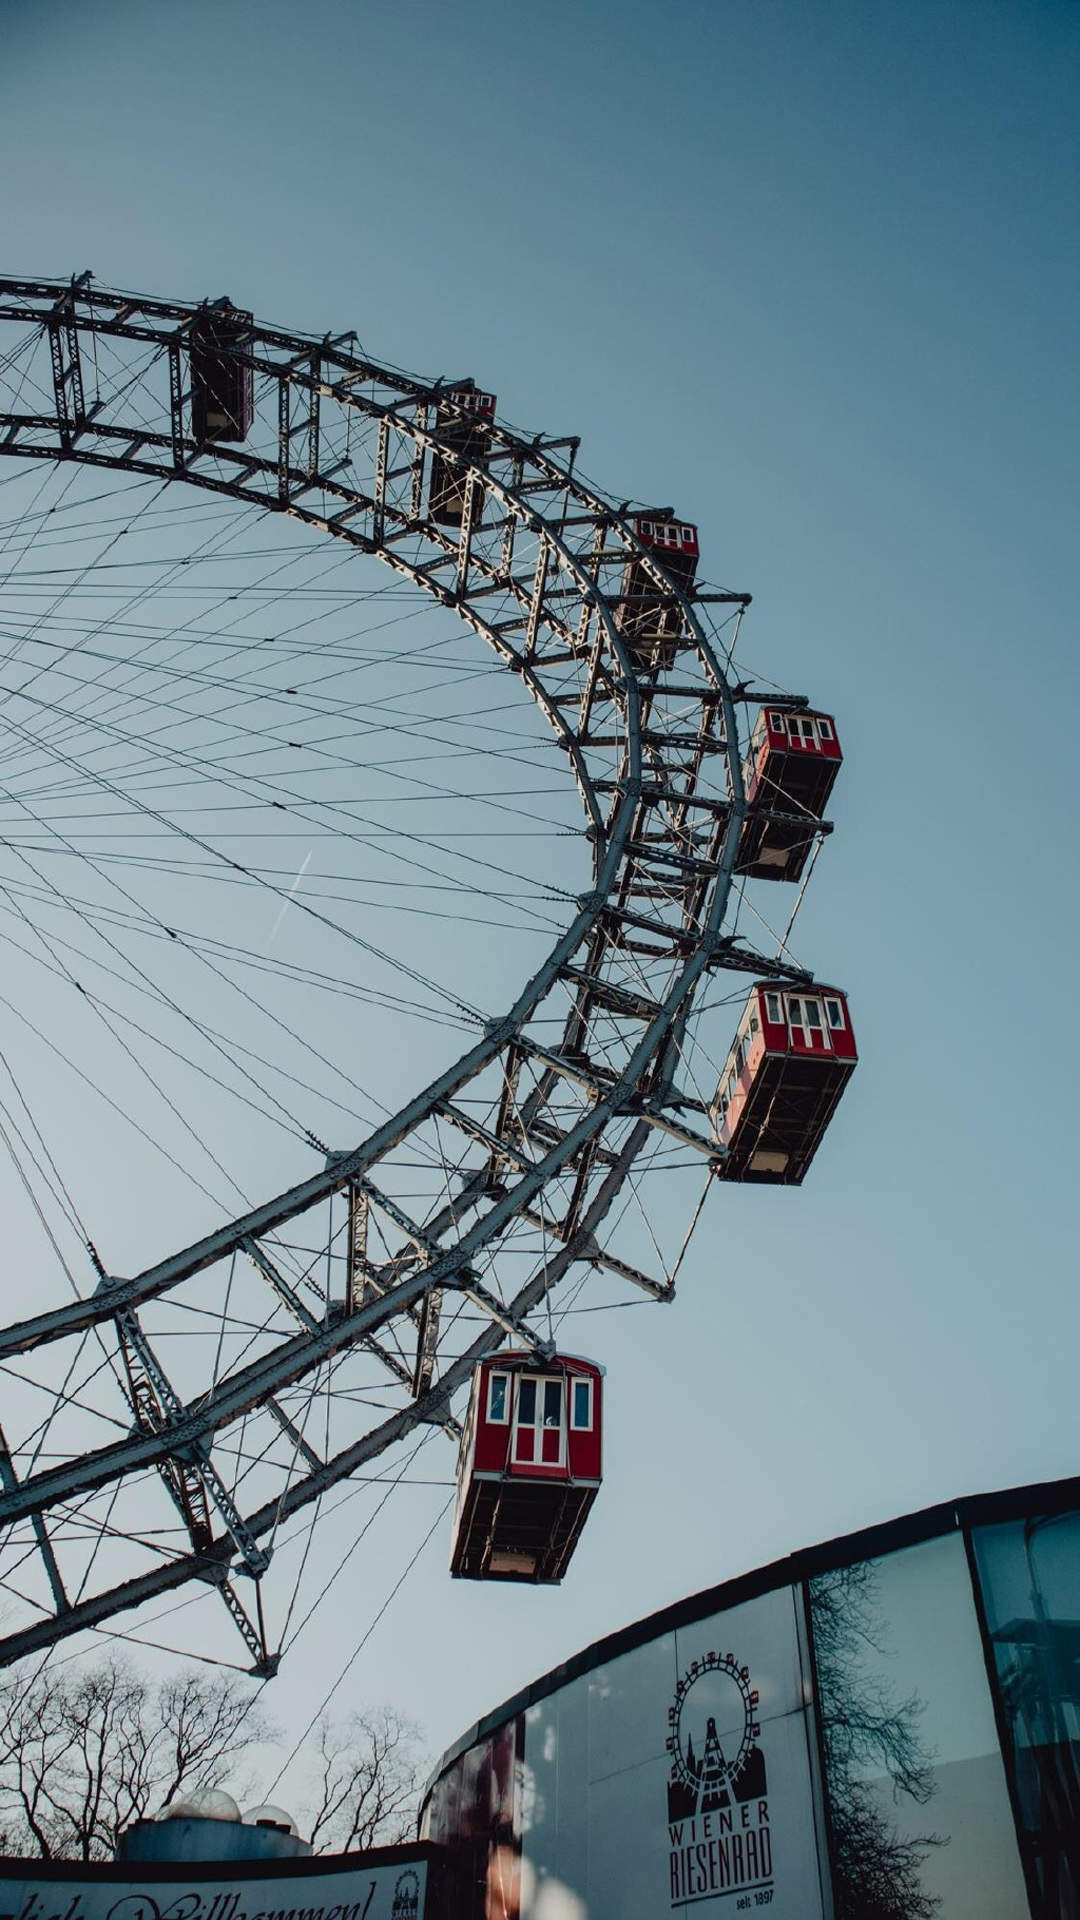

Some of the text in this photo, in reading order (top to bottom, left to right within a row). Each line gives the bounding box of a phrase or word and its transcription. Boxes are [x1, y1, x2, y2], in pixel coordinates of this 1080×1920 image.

[668, 1800, 770, 1847] WIENER
[669, 1826, 773, 1899] RIESENRAD
[736, 1889, 774, 1910] seit 1897
